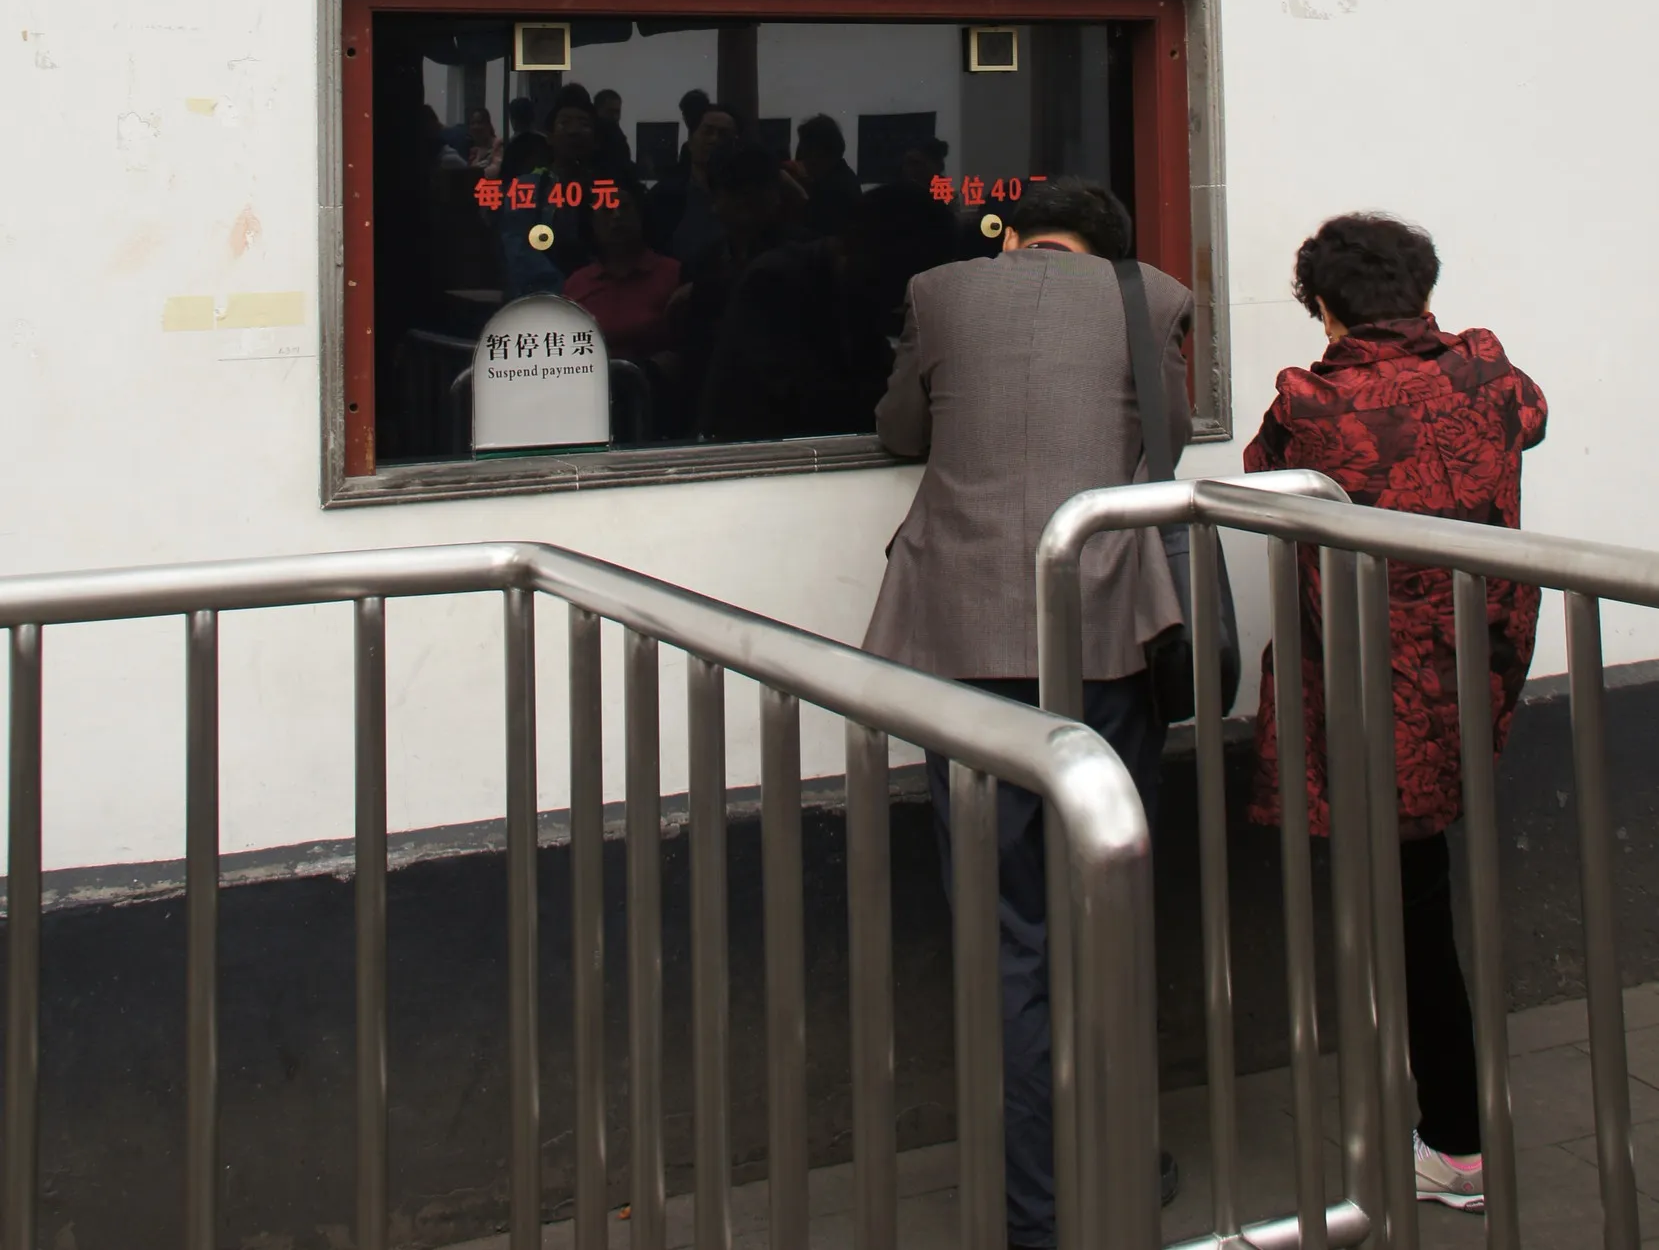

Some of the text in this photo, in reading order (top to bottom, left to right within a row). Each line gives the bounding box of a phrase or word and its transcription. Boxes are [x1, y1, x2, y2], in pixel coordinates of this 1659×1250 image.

[485, 329, 594, 361] 暂停售票
[488, 364, 593, 381] Suspend payment
